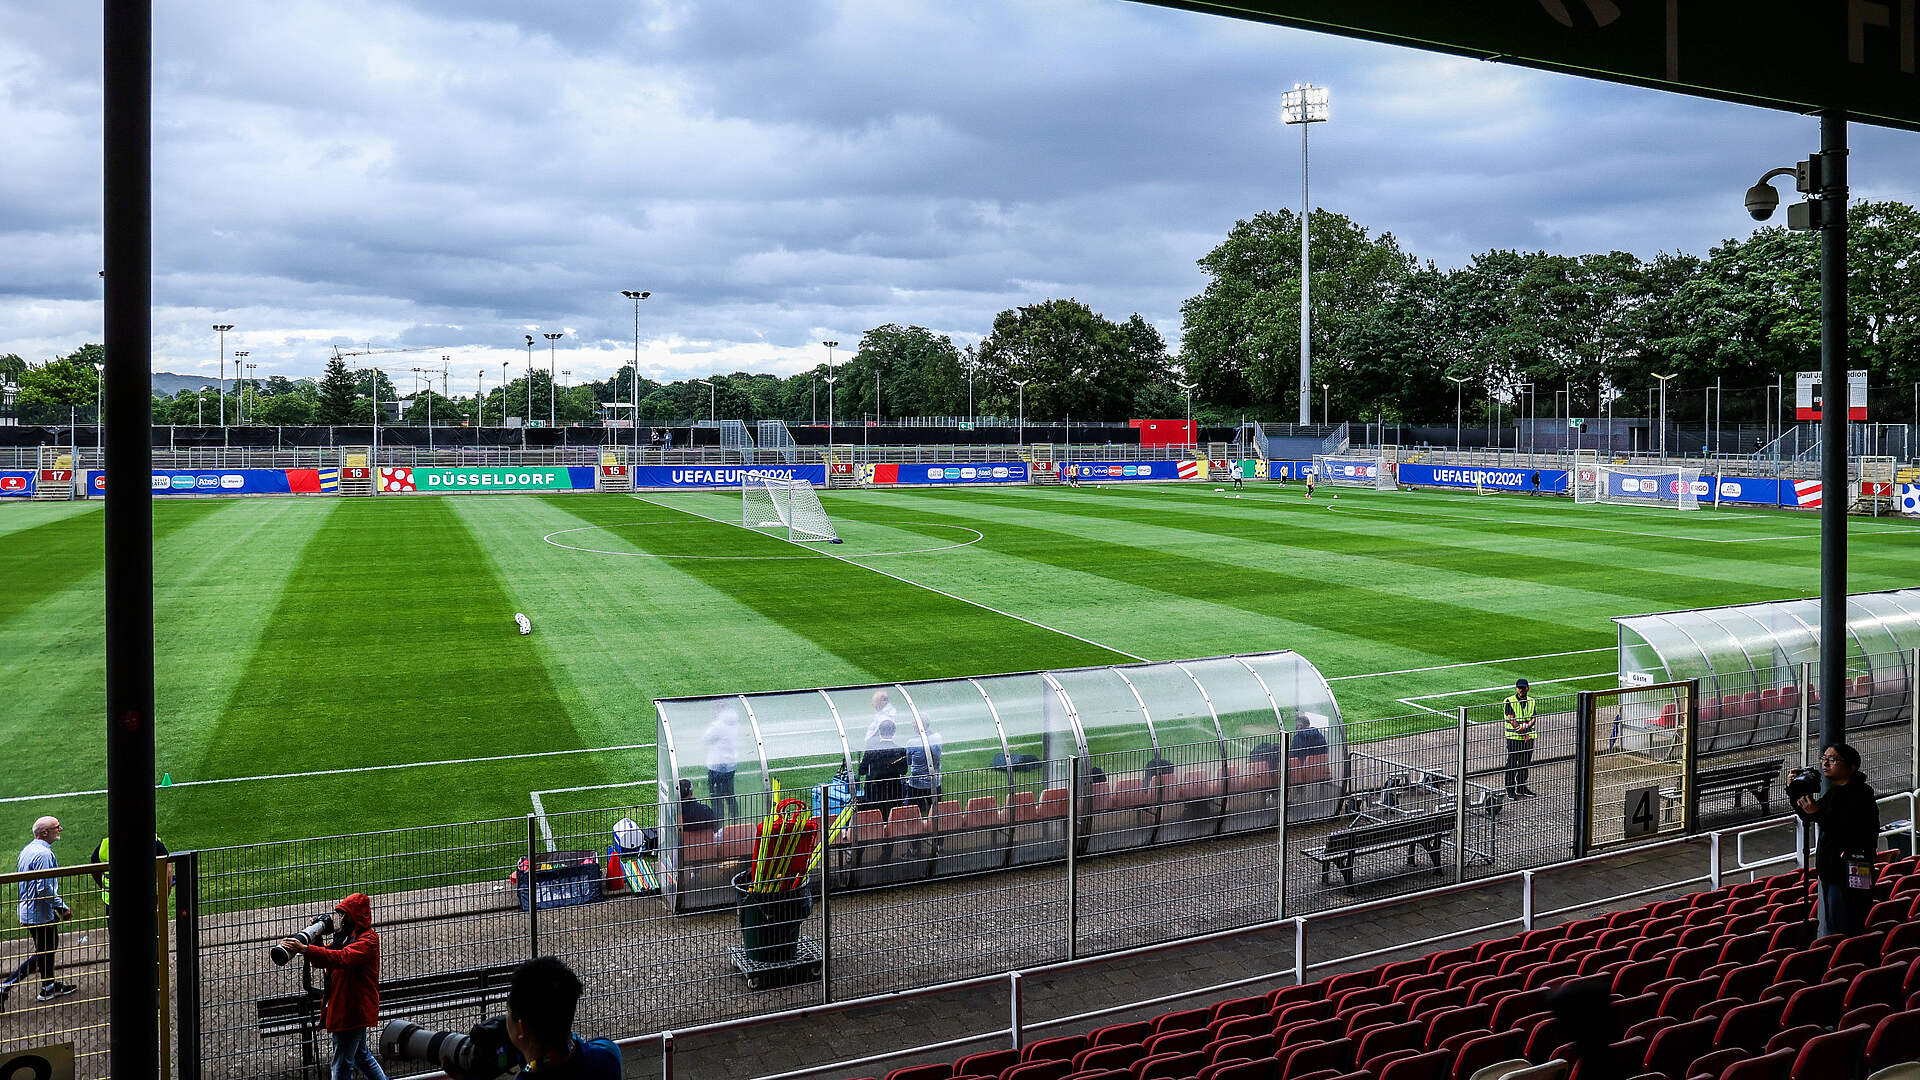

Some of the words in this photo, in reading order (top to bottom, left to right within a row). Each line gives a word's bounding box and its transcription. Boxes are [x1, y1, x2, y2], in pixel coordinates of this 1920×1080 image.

[609, 466, 619, 475] 15
[837, 464, 846, 472] 14
[51, 471, 65, 481] 17
[350, 469, 362, 478] 16
[428, 471, 556, 486] DÜSSELDORF
[1581, 470, 1591, 481] 10
[1872, 483, 1881, 494] 9
[1632, 790, 1654, 832] 4
